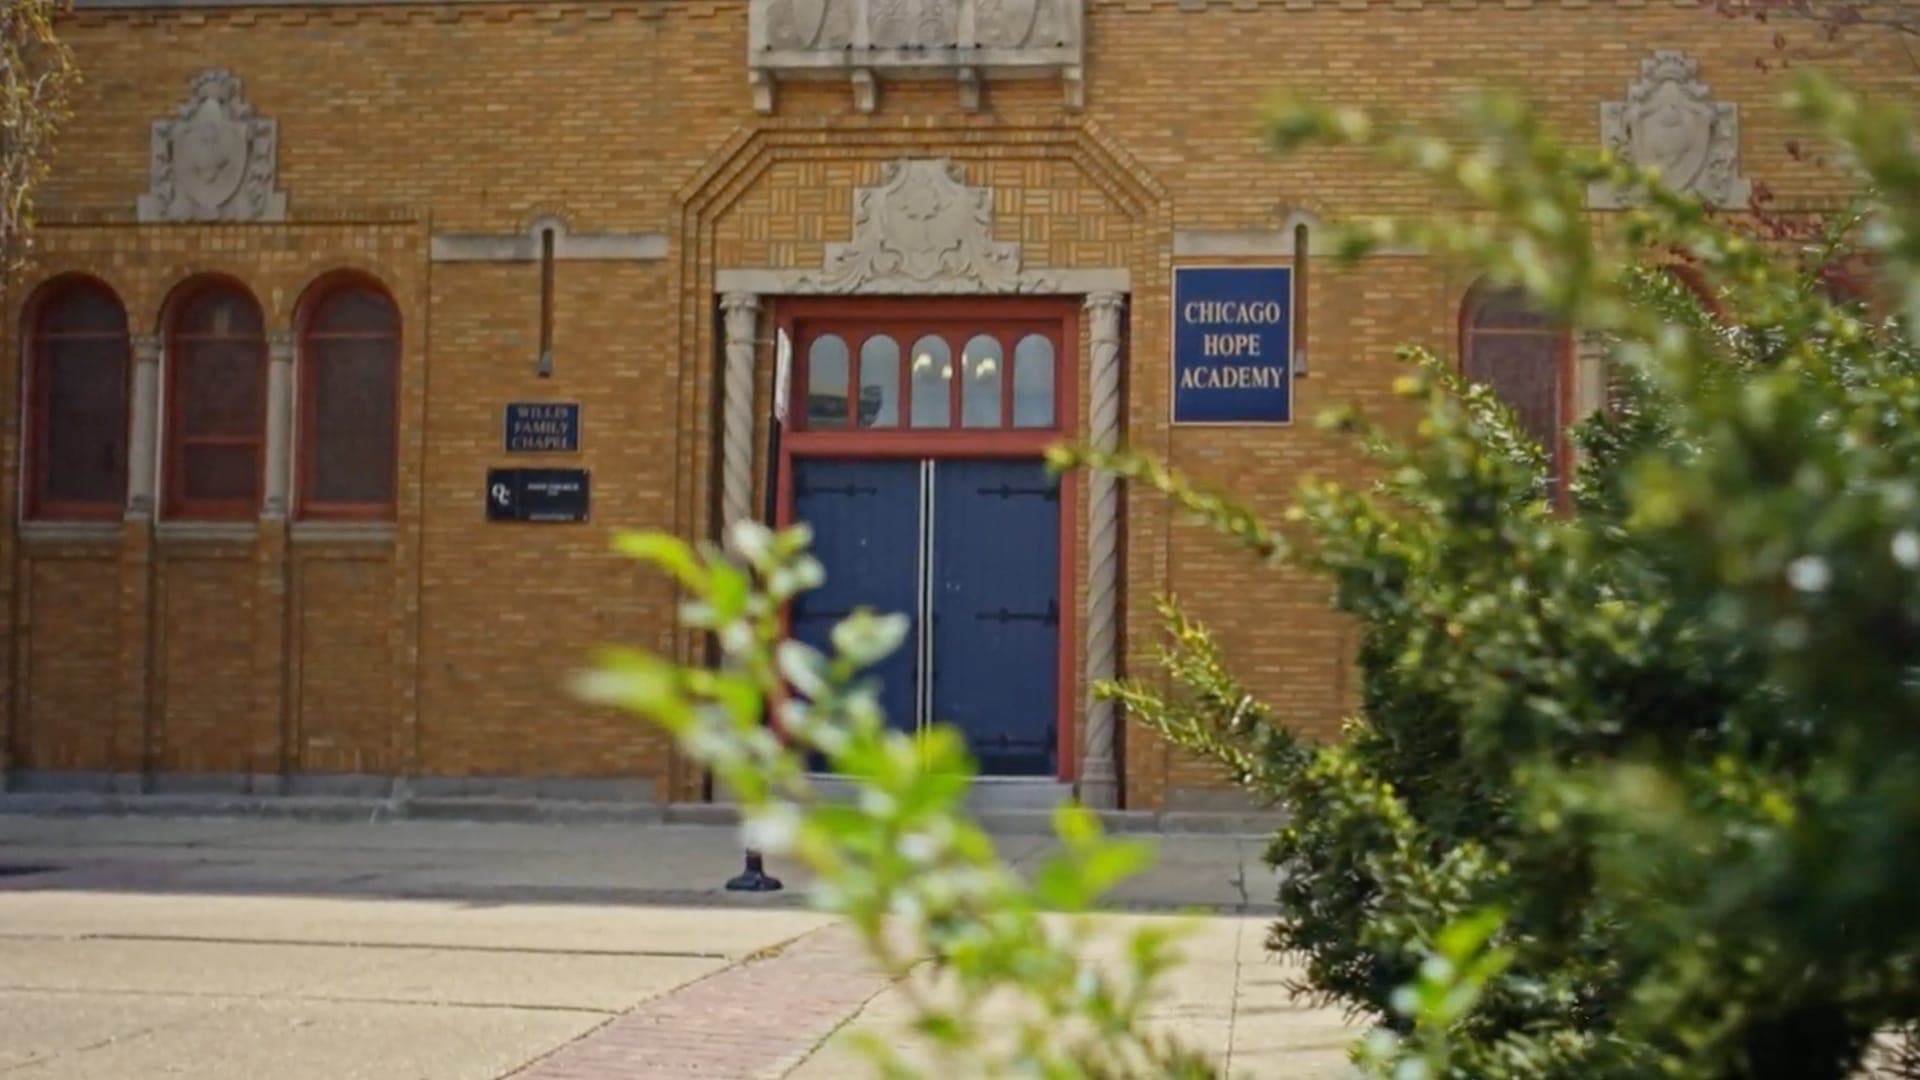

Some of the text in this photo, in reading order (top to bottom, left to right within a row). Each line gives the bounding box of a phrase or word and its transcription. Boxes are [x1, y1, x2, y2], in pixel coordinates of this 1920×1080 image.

[1184, 302, 1281, 324] CHICAGO
[1204, 334, 1261, 356] HOPE
[1181, 366, 1283, 389] ACADEMY
[514, 421, 568, 433] FAMILY
[511, 436, 567, 448] CHAPEL
